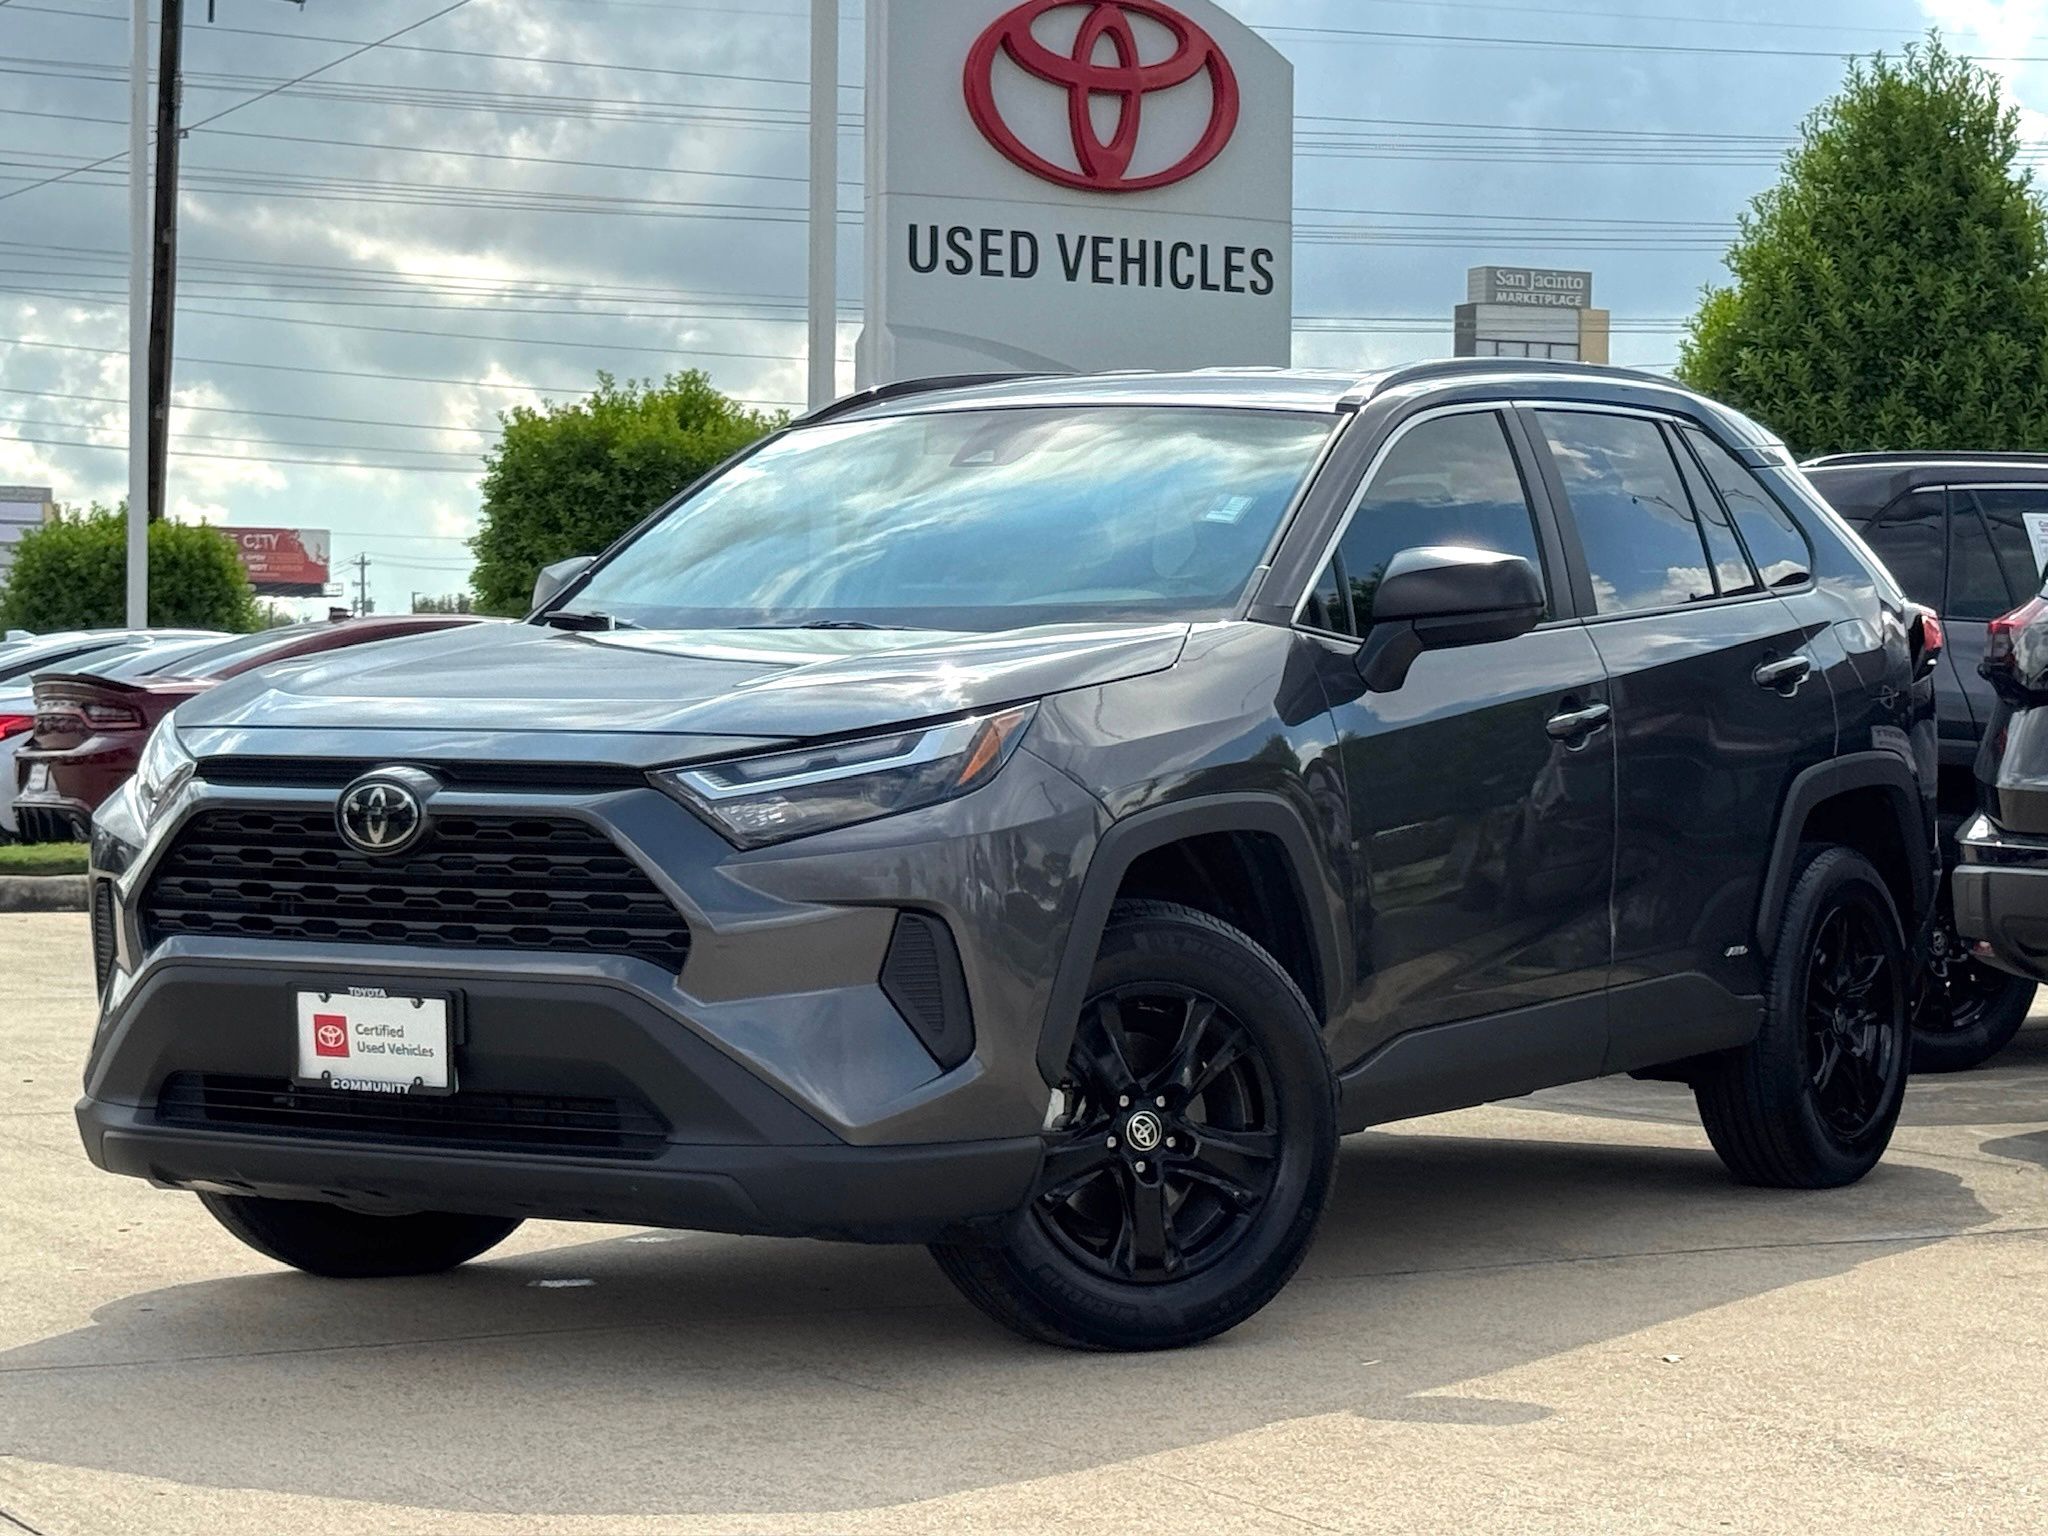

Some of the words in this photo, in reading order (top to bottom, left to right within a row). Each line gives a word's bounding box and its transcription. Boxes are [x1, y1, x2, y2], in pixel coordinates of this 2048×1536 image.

[908, 223, 1039, 279] USED
[1056, 233, 1274, 295] VEHICLES
[1496, 270, 1525, 286] San
[1528, 271, 1583, 291] Jacinto
[1496, 292, 1582, 306] MARKETPLACE
[243, 533, 280, 551] CITY
[348, 987, 387, 998] TOYOTA
[355, 1023, 404, 1038] Certified
[357, 1042, 386, 1053] Used
[387, 1043, 434, 1057] Vehicles
[331, 1078, 410, 1094] COMMUNITY
